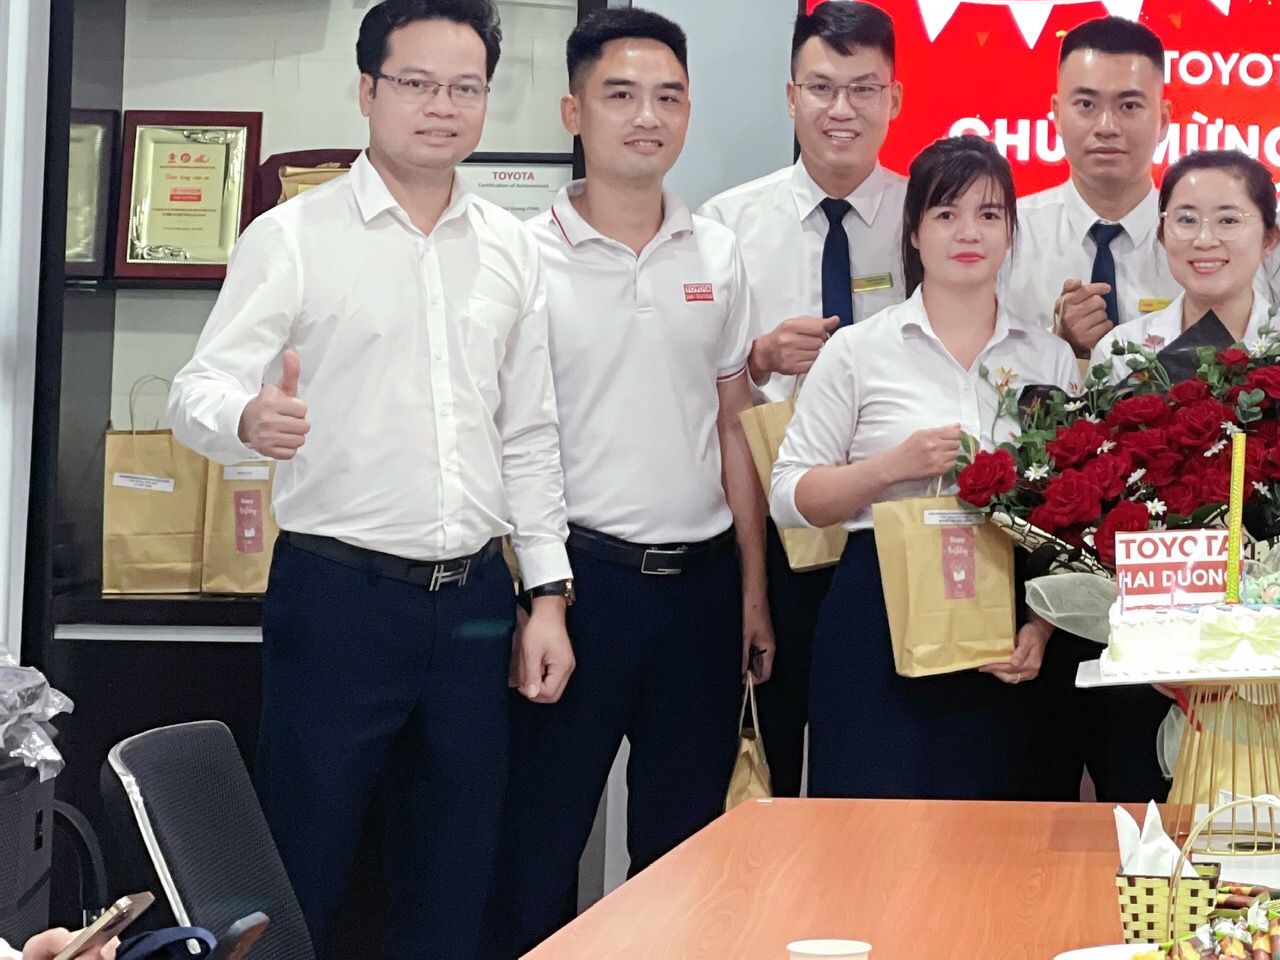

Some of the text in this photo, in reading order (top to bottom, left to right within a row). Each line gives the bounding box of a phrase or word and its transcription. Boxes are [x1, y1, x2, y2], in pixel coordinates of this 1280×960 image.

[492, 171, 535, 181] TOYOTA
[1119, 535, 1230, 560] TOYOTA
[1119, 571, 1155, 589] HAI
